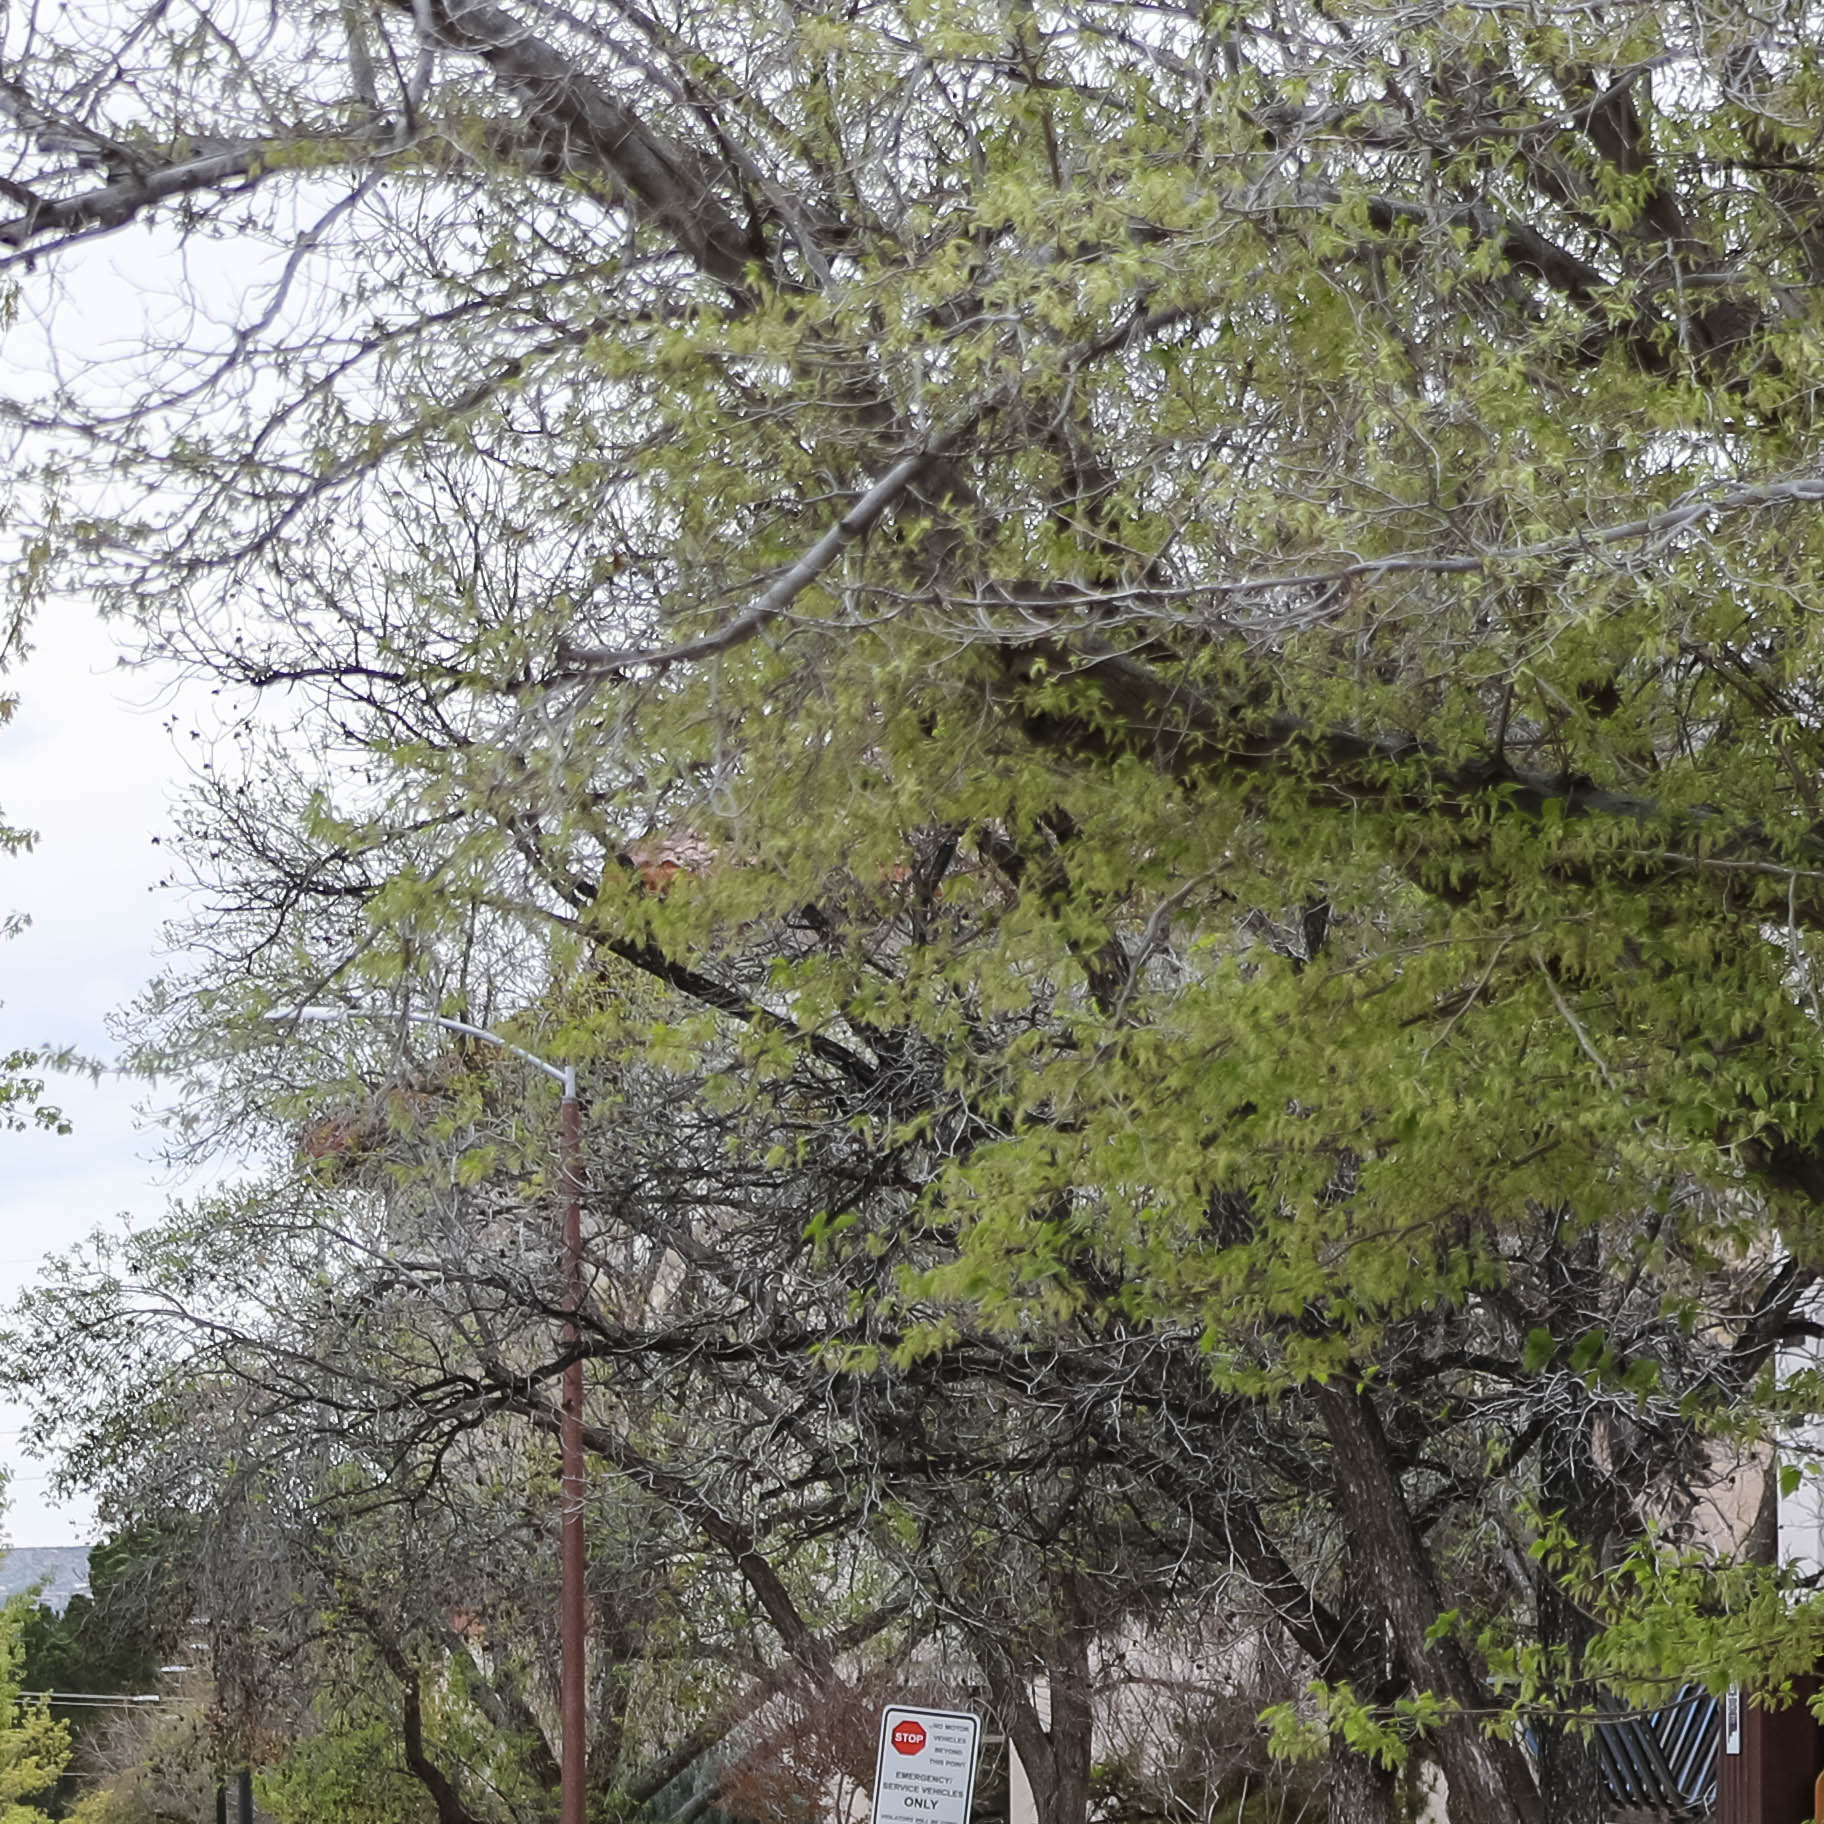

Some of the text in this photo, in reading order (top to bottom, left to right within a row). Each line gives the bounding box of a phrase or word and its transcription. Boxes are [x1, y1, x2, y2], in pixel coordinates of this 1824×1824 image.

[895, 1732, 924, 1744] STOP
[883, 1782, 964, 1798] SERVICE VEHICLES
[904, 1796, 939, 1810] ONLY
